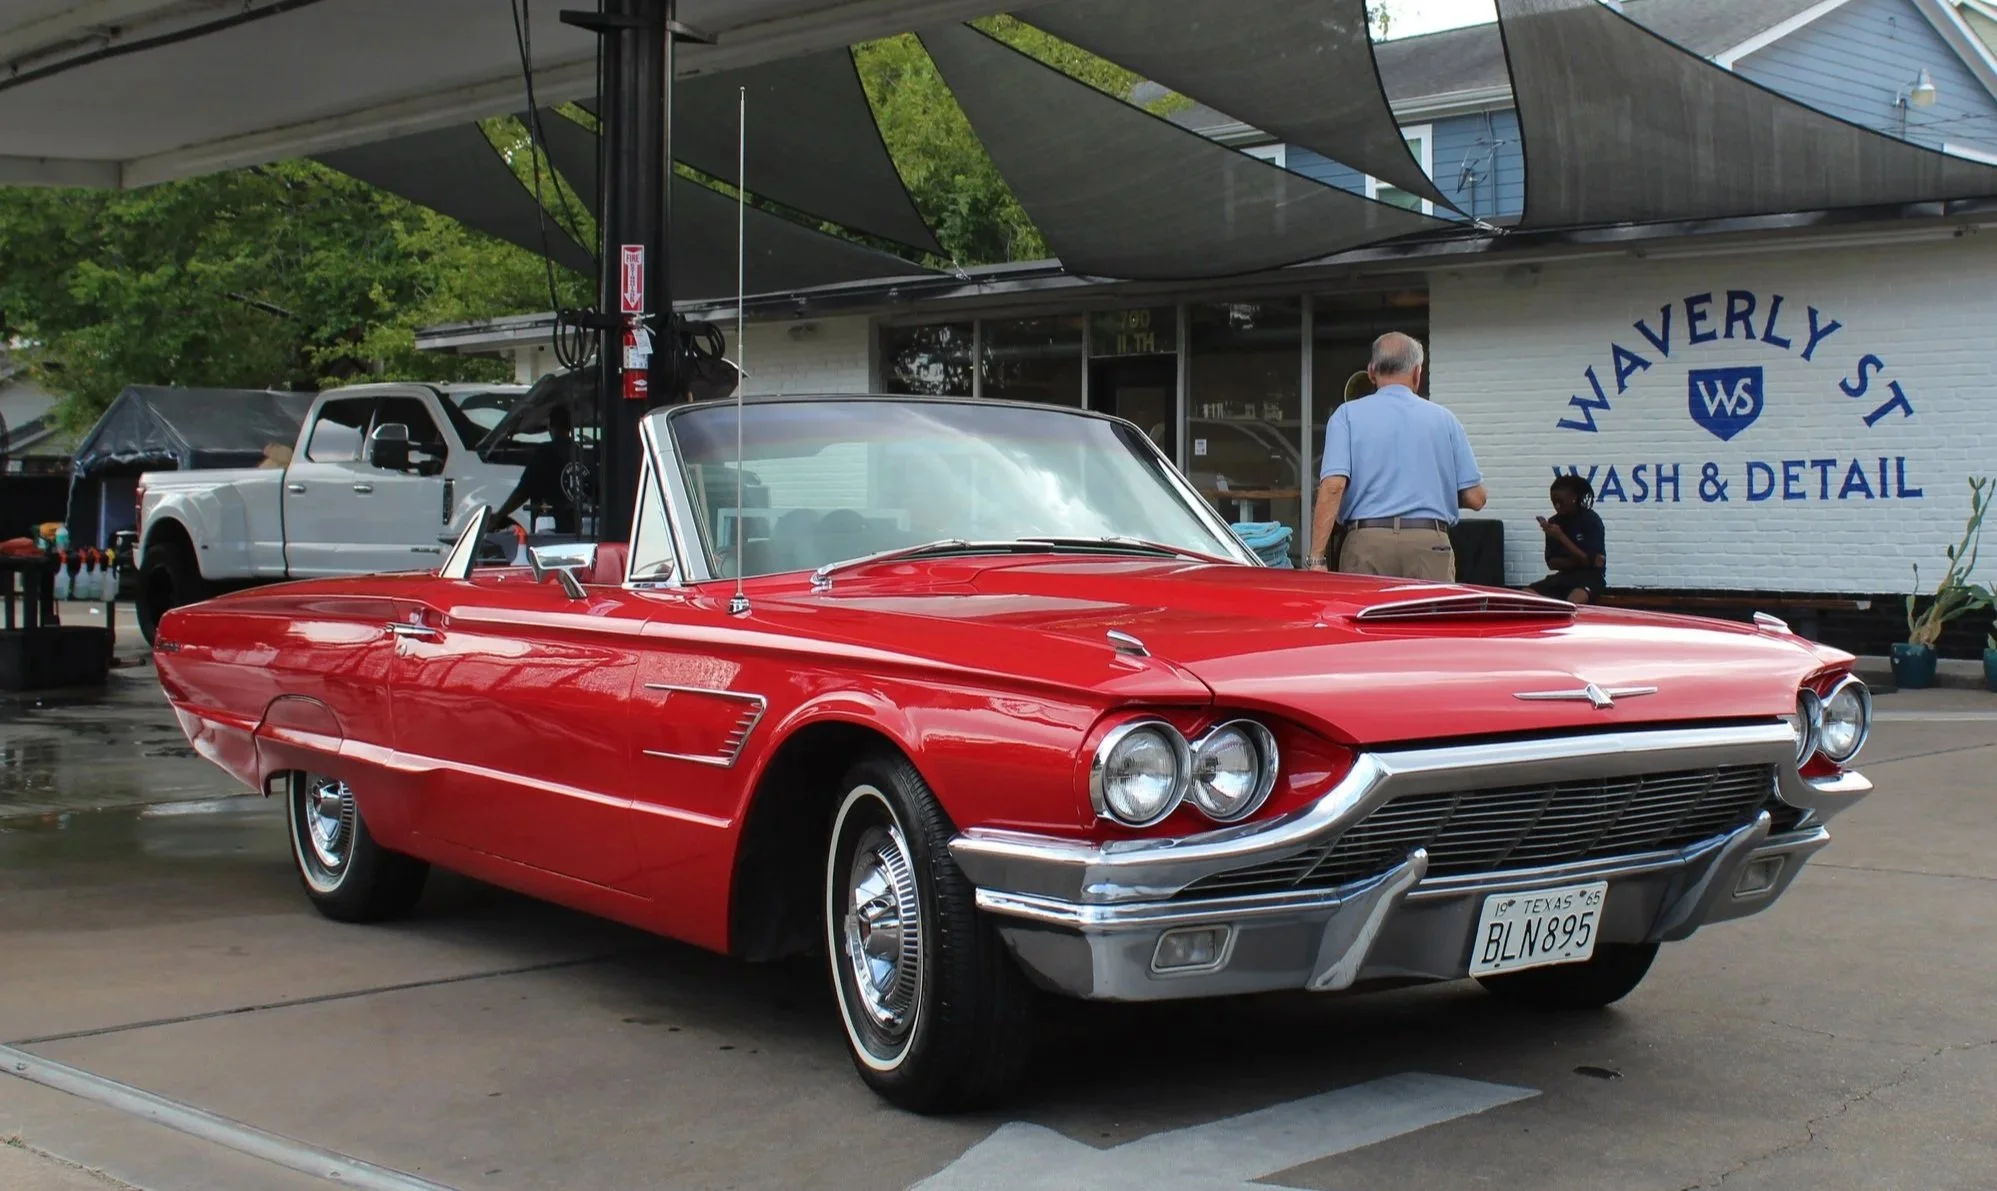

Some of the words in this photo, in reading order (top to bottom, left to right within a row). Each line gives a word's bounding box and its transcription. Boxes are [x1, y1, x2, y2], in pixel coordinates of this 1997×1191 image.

[1556, 290, 1842, 433] WAVERLY
[1839, 353, 1914, 428] ST
[1696, 377, 1754, 417] WS
[1699, 461, 1729, 503] &
[1746, 456, 1923, 502] DETAIL
[1524, 895, 1573, 915] TEXAS
[1585, 890, 1601, 906] 65
[1480, 911, 1594, 964] BLN895
